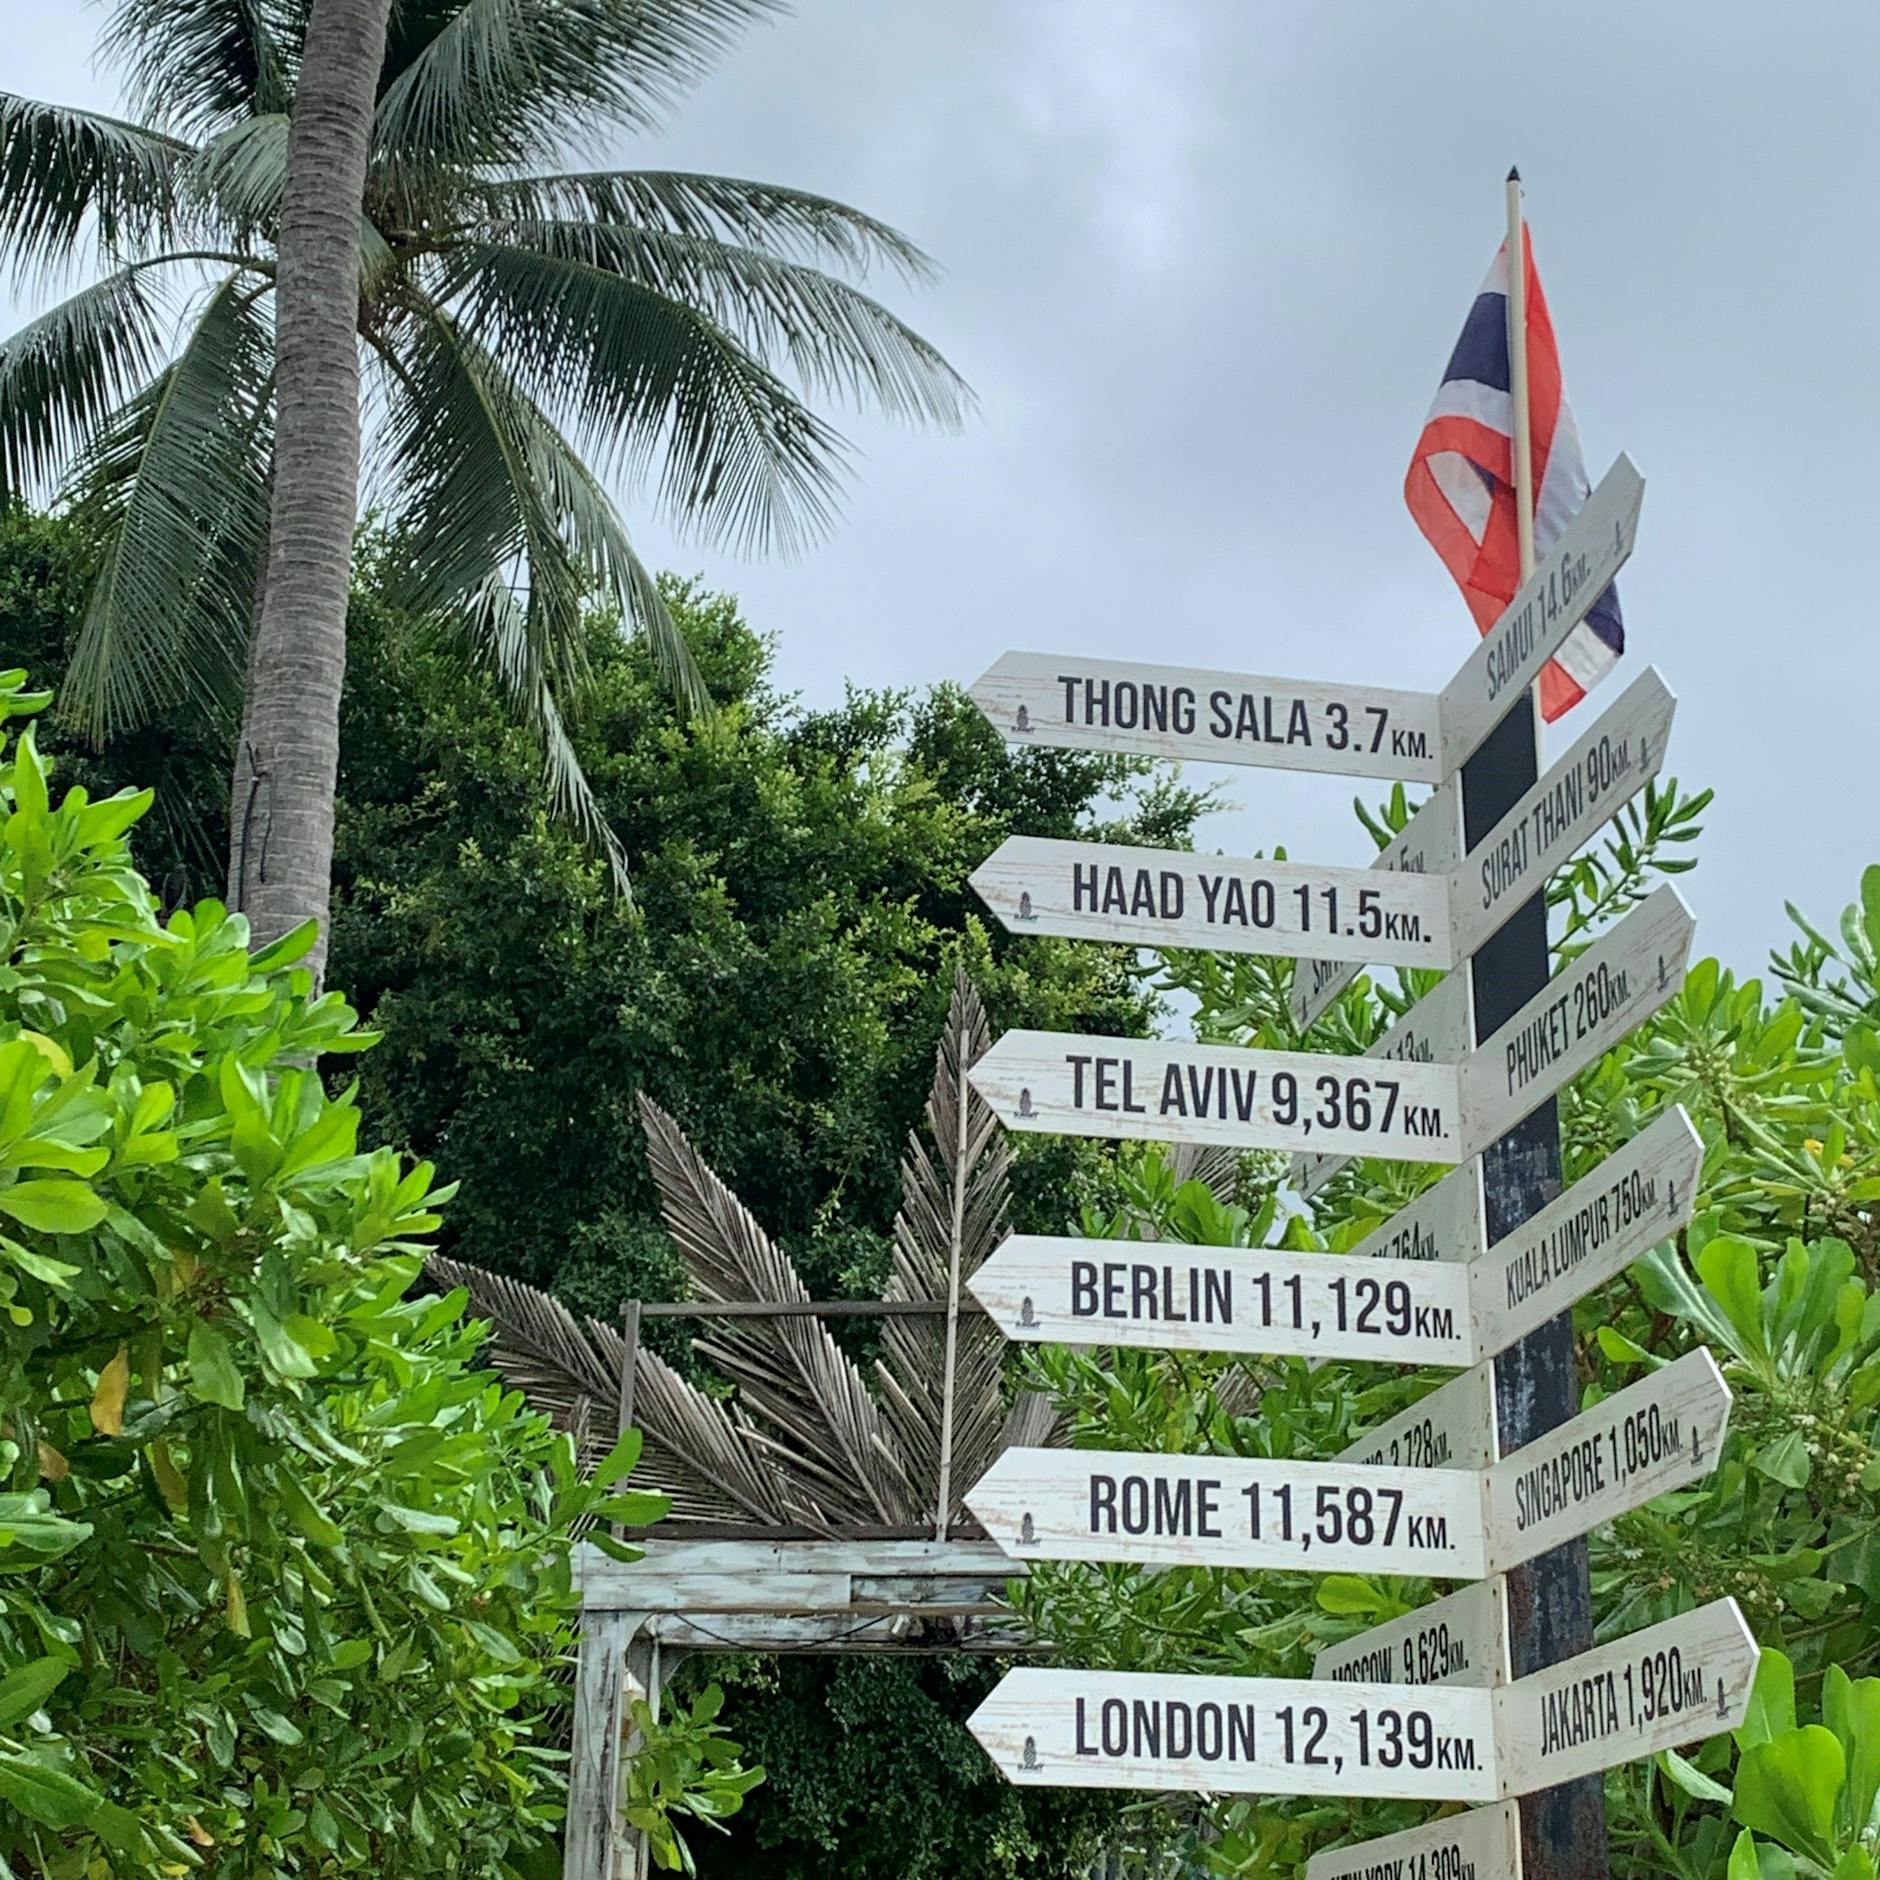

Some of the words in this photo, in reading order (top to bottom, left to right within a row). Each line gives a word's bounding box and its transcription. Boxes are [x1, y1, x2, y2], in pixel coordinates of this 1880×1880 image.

[1486, 610, 1535, 702] SAMUI
[1057, 674, 1197, 735] THONG
[1209, 690, 1313, 747] SALA
[1482, 819, 1529, 911] SURAT
[1532, 768, 1583, 858] THANI
[1072, 861, 1185, 921] HAAD
[1197, 873, 1276, 930] YAO
[1292, 883, 1433, 944] 11.5KM.
[1505, 993, 1569, 1097] PHUKET
[1574, 960, 1632, 1041] 260KM.
[1066, 1053, 1147, 1114] TEL
[1159, 1062, 1258, 1122] AVIV
[1071, 1260, 1233, 1325] BERLIN
[1505, 1238, 1551, 1311] KUALA
[1549, 1192, 1610, 1278] LUMPUR
[1089, 1473, 1223, 1539] ROME
[1515, 1432, 1605, 1532] SINGAPORE
[1075, 1695, 1256, 1763] LONDON
[1540, 1671, 1620, 1758] JAKARTA
